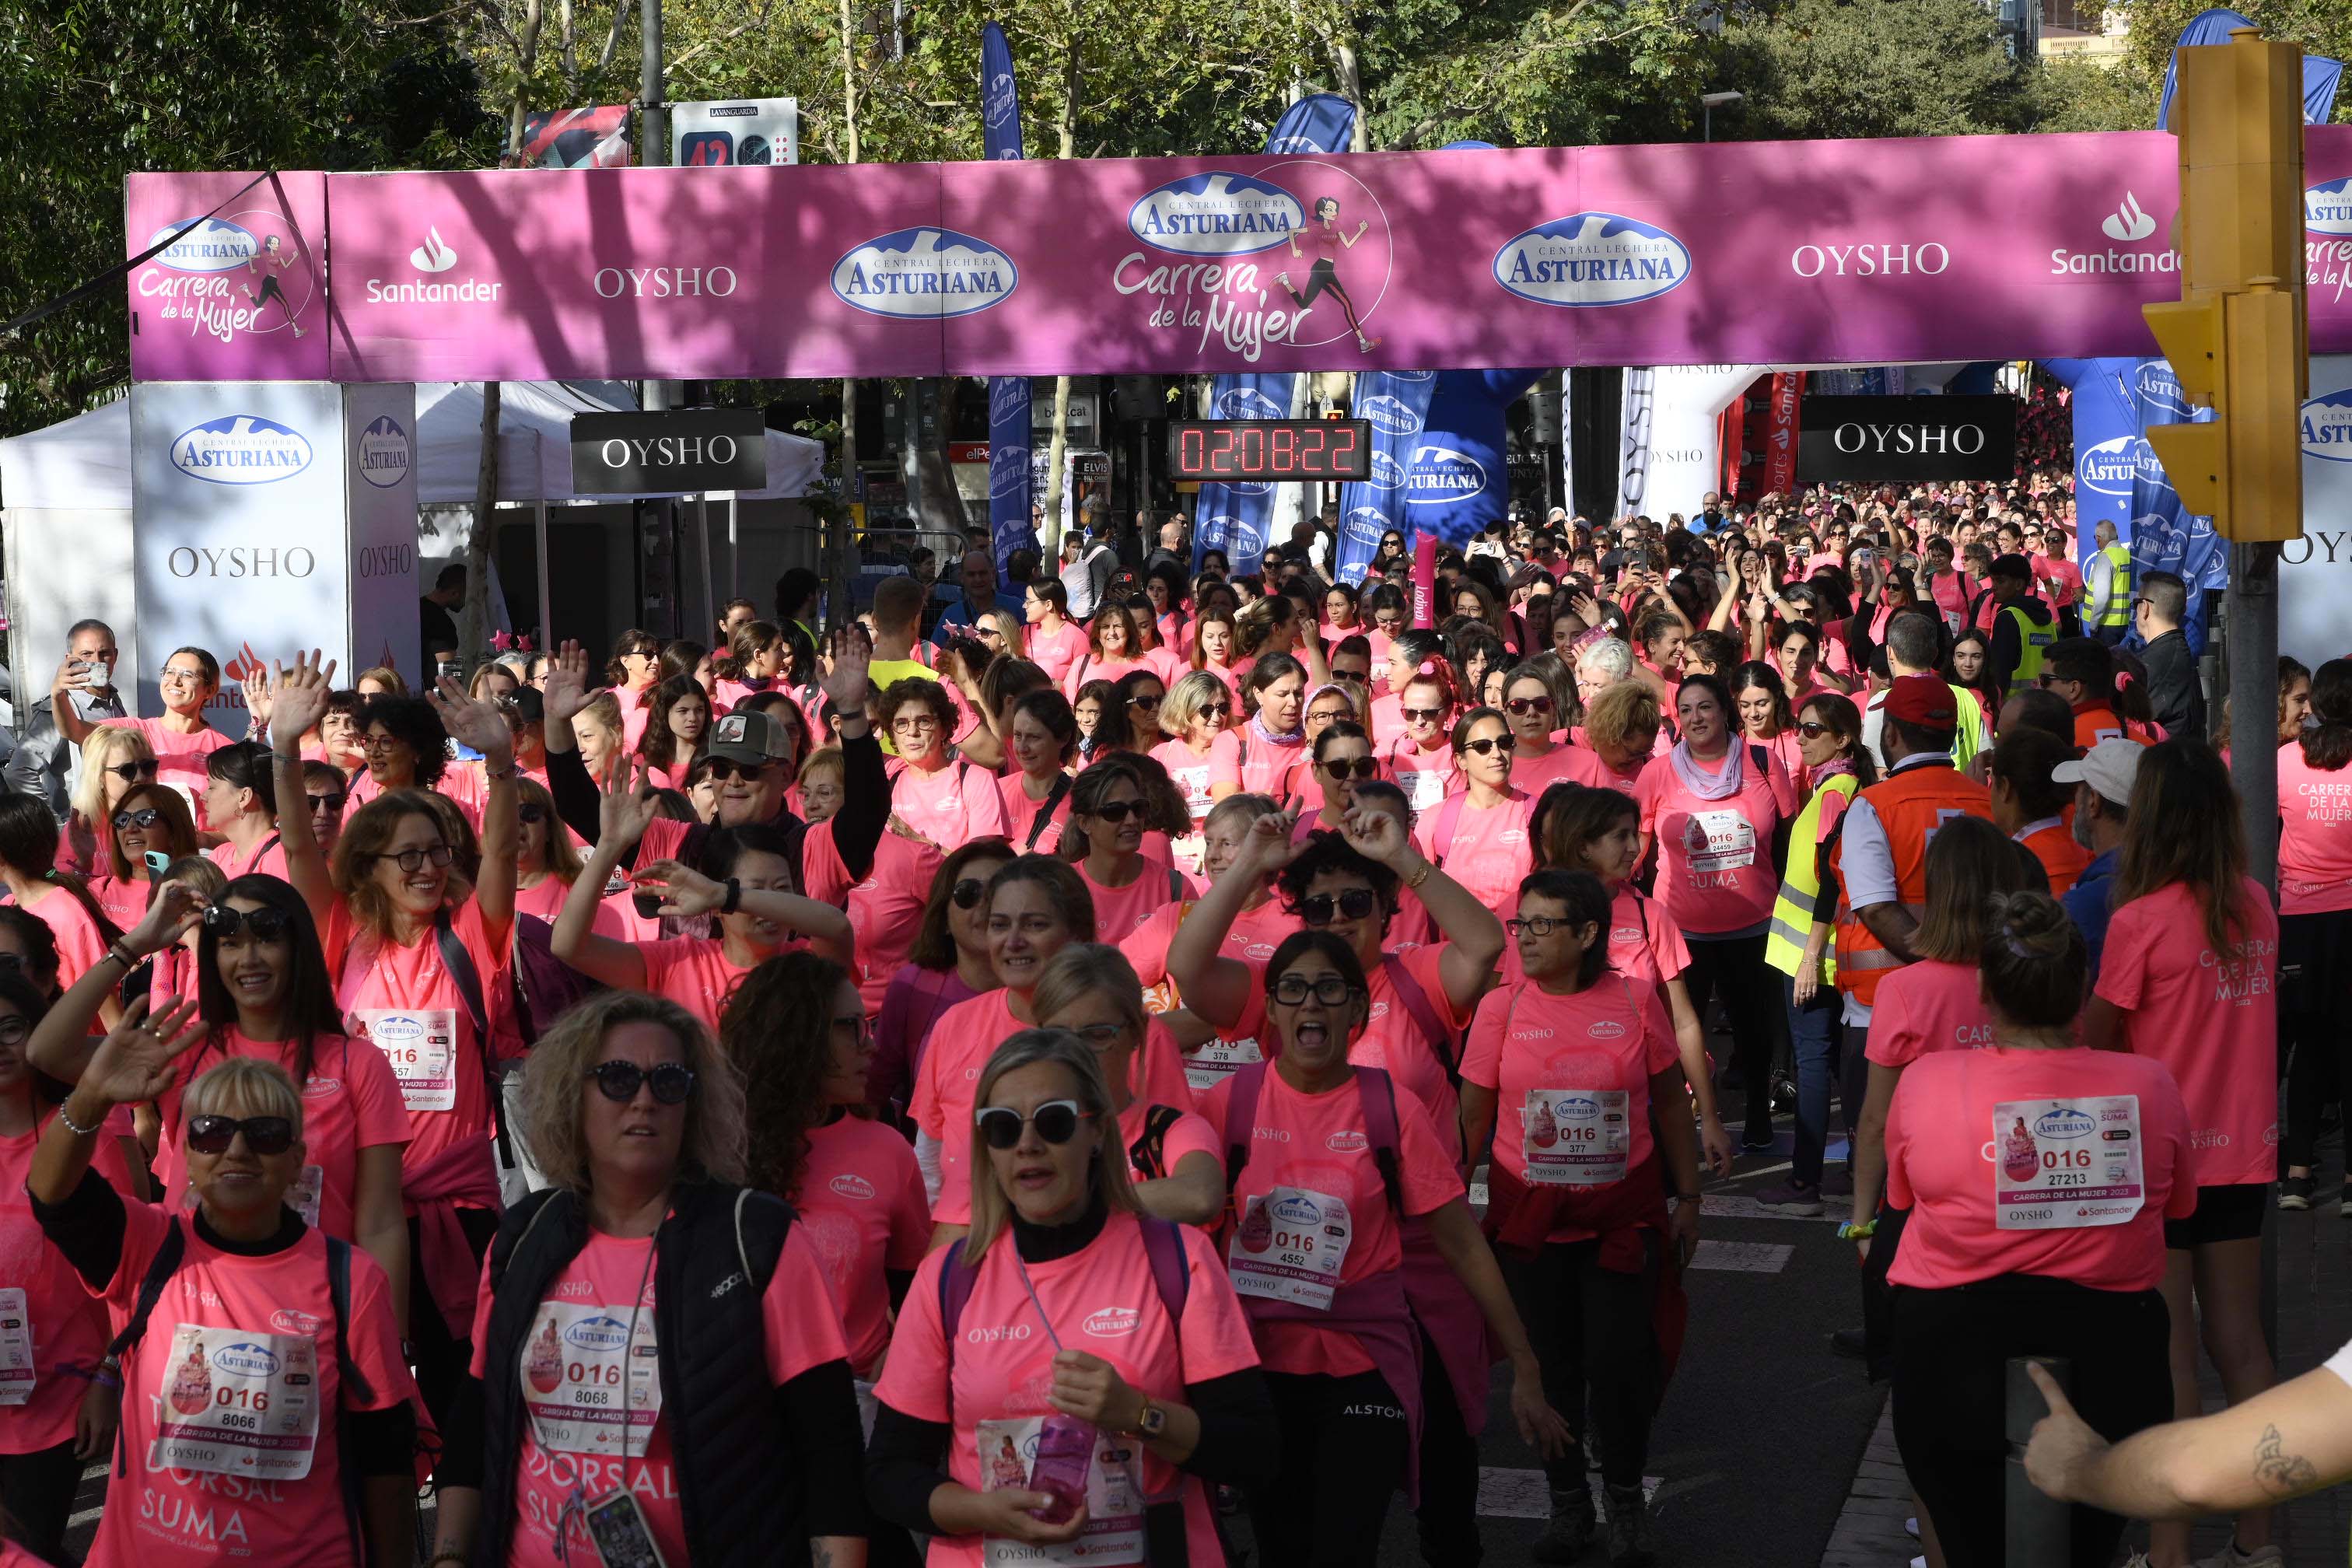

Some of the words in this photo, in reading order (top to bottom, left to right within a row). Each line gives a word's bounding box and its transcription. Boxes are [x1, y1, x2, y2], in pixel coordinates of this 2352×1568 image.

[1169, 201, 1227, 210] CENTRAL
[1230, 199, 1285, 208] LECHERA
[1142, 204, 1291, 235] ASTURIANA
[1538, 244, 1600, 255] CENTRAL
[1607, 243, 1669, 254] LECHERA
[873, 259, 932, 269] CENTRAL
[939, 257, 996, 268] LECHERA
[1507, 248, 1676, 284] ASTURIANA
[1791, 243, 1950, 278] OYSHO
[2051, 248, 2182, 275] Santand
[845, 261, 1003, 296] ASTURIANA
[1114, 252, 1258, 296] Carrera
[2323, 265, 2336, 285] la
[138, 268, 229, 297] Carrera
[367, 278, 502, 303] Santander
[593, 267, 737, 299] OYSHO
[161, 298, 179, 319] de
[181, 297, 194, 319] la
[192, 292, 264, 342] Mujer
[1150, 297, 1176, 327] de
[1183, 296, 1202, 327] la
[1198, 289, 1313, 362] Mujer
[1045, 406, 1087, 418] bo.cat
[1362, 403, 1412, 431] ASTURIANA
[1833, 421, 1985, 455] OYSHO
[181, 440, 301, 468] ASTURIANA
[362, 443, 404, 470] ASTURIANA
[601, 435, 737, 468] OYSHO
[1181, 429, 1354, 472] 02:08:22
[1084, 462, 1108, 473] ELVIS
[168, 547, 315, 577] OYSHO
[359, 543, 411, 578] OYSHO
[1414, 585, 1430, 621] Ladivol
[2310, 796, 2328, 809] DE
[2333, 796, 2350, 809] LA
[2306, 809, 2352, 821] MUJER
[1710, 833, 1733, 844] 016
[2217, 963, 2241, 983] DE
[2247, 959, 2265, 977] LA
[2214, 977, 2270, 1002] MUJER
[378, 1025, 420, 1034] ASTURIANA
[1512, 1027, 1554, 1041] OYSHO
[1589, 1027, 1624, 1035] ASTURIANA
[1213, 1051, 1229, 1061] 378
[1558, 1104, 1597, 1115] ASTURIANA
[2101, 1113, 2129, 1122] SUMA
[1560, 1127, 1595, 1141] 016
[2039, 1120, 2092, 1134] ASTURIANA
[1252, 1127, 1291, 1144] YSHO
[1330, 1137, 1367, 1147] ASTURIANA
[2190, 1134, 2229, 1150] YSHO
[1570, 1144, 1586, 1153] 377
[2042, 1149, 2091, 1168] 016
[1535, 1167, 1566, 1177] OYSHO
[2049, 1174, 2087, 1185] 27213
[834, 1181, 872, 1195] ASTURIANA
[2014, 1192, 2051, 1202] CARRERA
[2079, 1189, 2107, 1198] MUJER
[1277, 1206, 1318, 1222] ASTURIANA
[2009, 1209, 2053, 1222] OYSHO
[2088, 1206, 2133, 1216] Santander
[1276, 1231, 1314, 1252] 016
[1280, 1253, 1305, 1266] 4552
[1243, 1262, 1276, 1275] CARRERA
[1299, 1271, 1320, 1283] MUJER
[1237, 1276, 1276, 1290] OYSHO
[968, 1324, 1031, 1345] OYSHO
[219, 1354, 276, 1370] ASTURIANA
[568, 1362, 621, 1385] 016
[216, 1386, 269, 1411] 016
[575, 1389, 608, 1405] 8068
[572, 1409, 586, 1418] DE
[587, 1411, 598, 1419] LA
[1343, 1404, 1405, 1419] ALSTOM
[221, 1413, 255, 1429] 8066
[173, 1426, 218, 1440] CARRERA
[219, 1433, 233, 1441] DE
[234, 1433, 247, 1442] LA
[249, 1435, 277, 1446] MUJER
[166, 1446, 215, 1462] OYSHO
[255, 1456, 302, 1469] Santander
[140, 1487, 249, 1544] SUMA
[996, 1545, 1046, 1561] OYSHO
